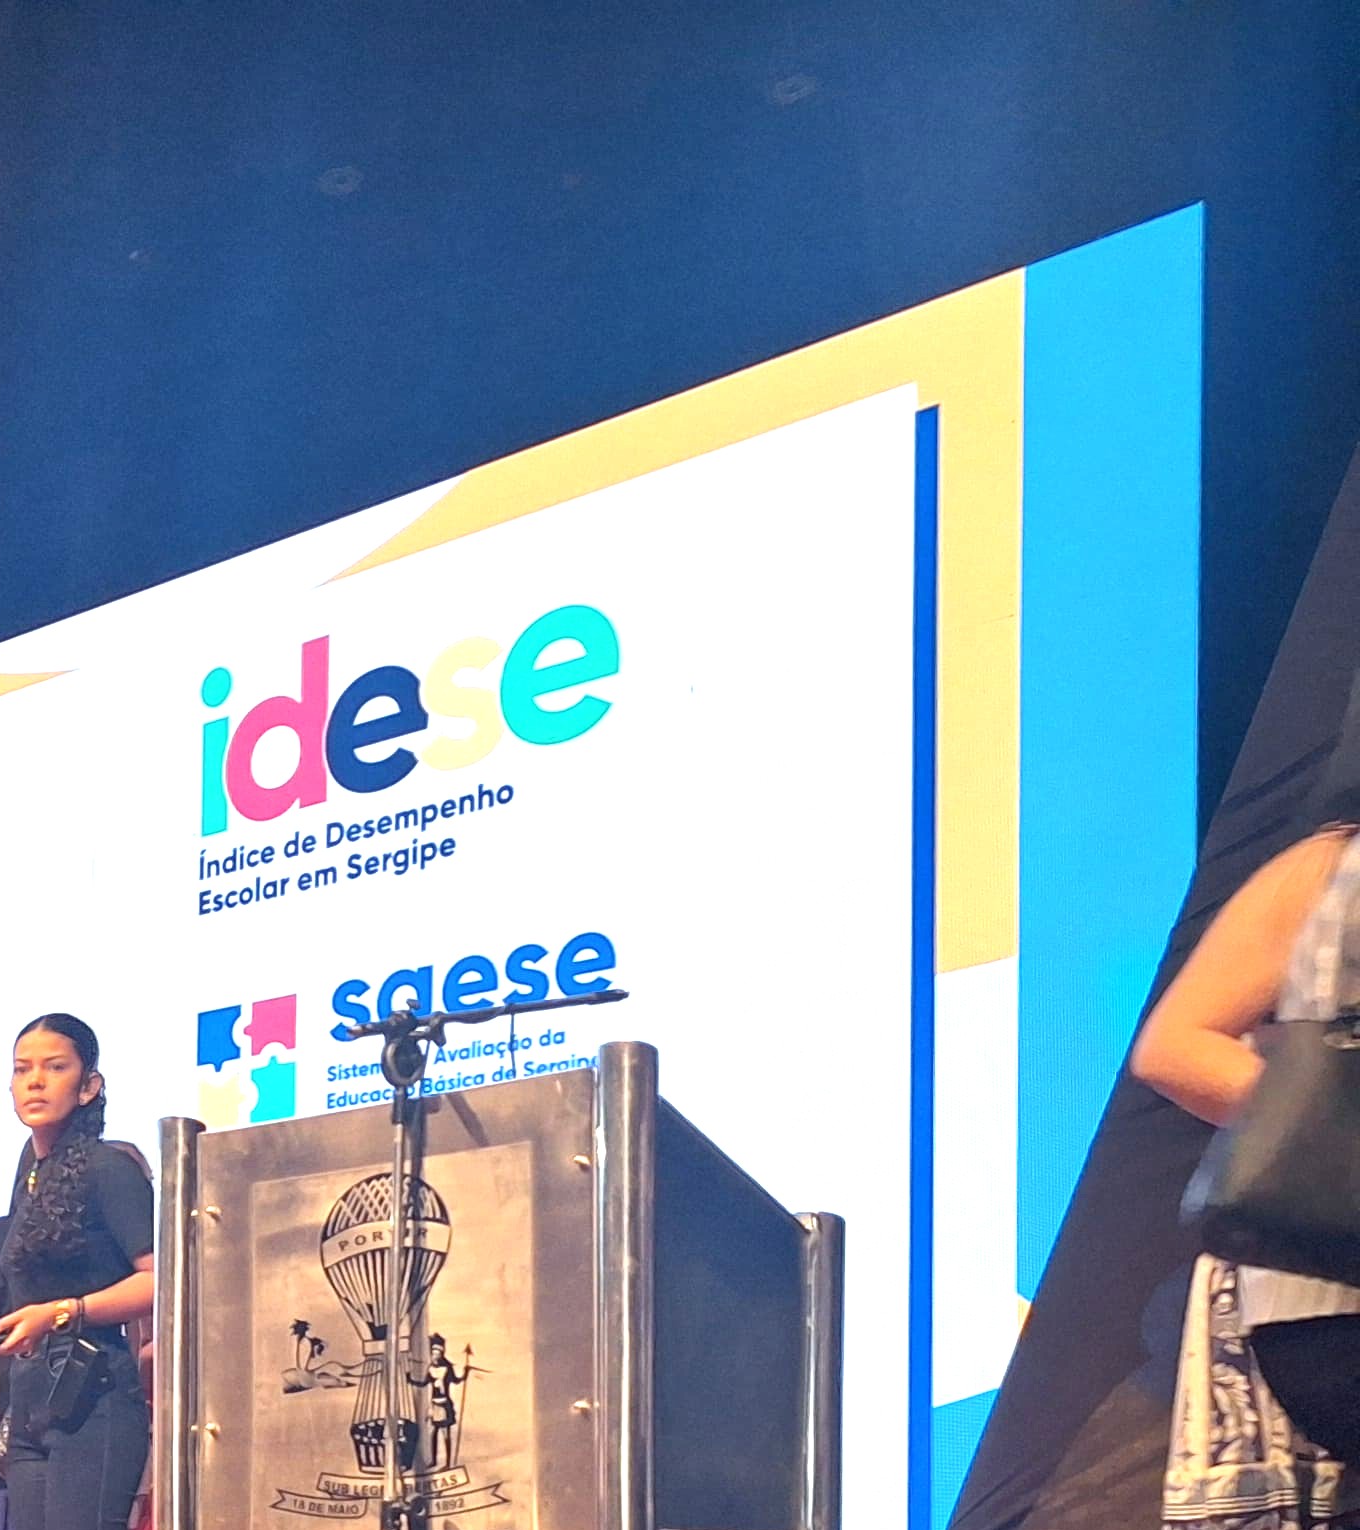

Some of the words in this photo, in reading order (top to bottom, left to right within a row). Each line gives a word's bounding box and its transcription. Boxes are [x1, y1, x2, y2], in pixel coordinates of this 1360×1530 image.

[201, 604, 621, 837] idese
[197, 876, 291, 917] Escolar
[296, 865, 338, 892] em
[346, 837, 457, 880] Sergipe
[198, 848, 276, 881] Índice
[283, 831, 317, 859] de
[325, 783, 515, 849] Desempenho
[330, 932, 617, 1042] saese
[539, 1028, 566, 1047] da
